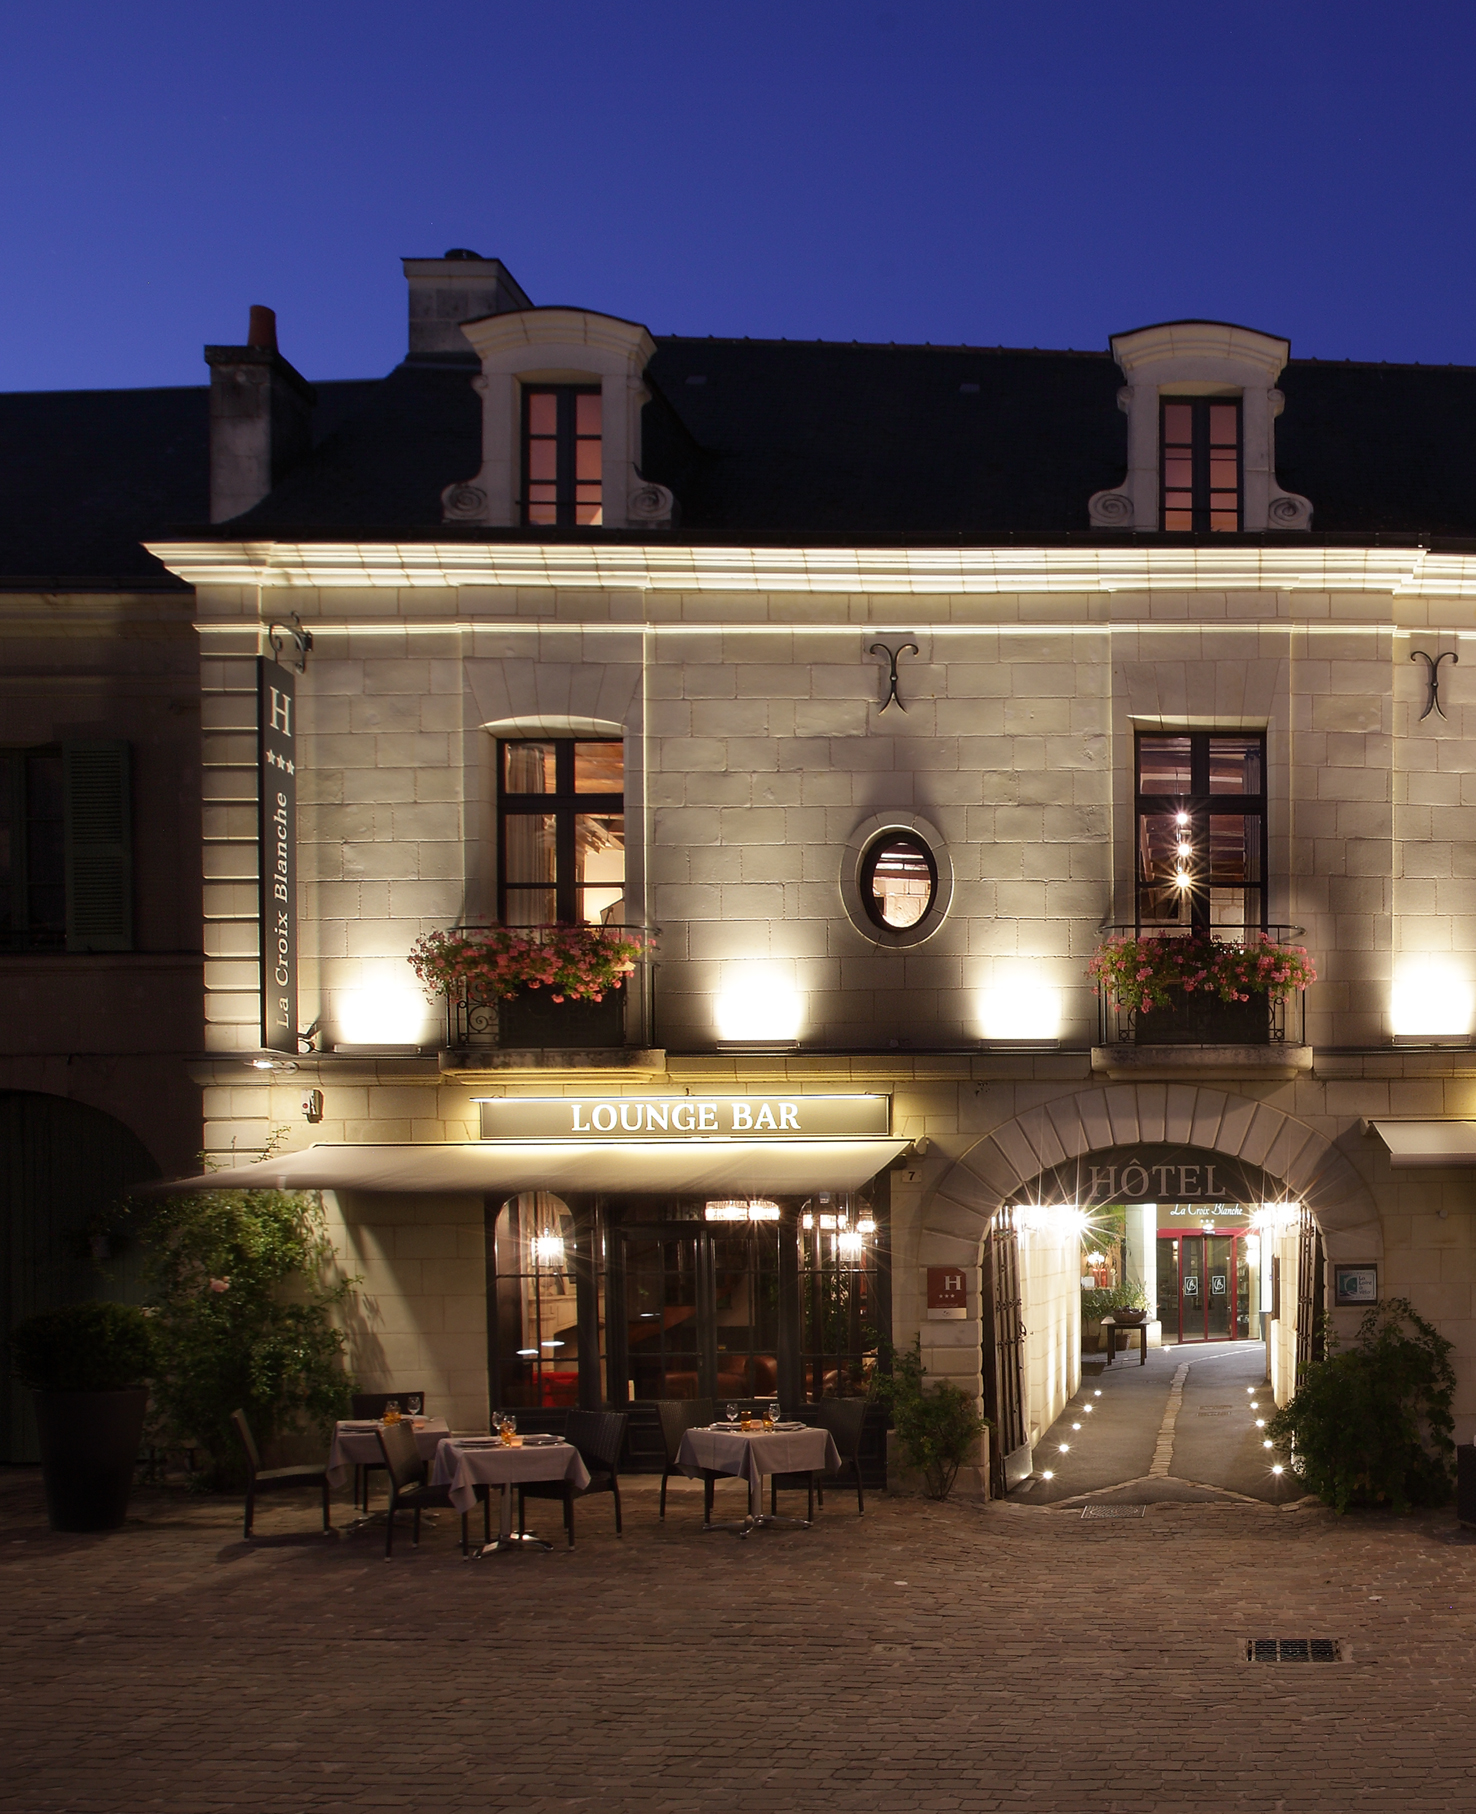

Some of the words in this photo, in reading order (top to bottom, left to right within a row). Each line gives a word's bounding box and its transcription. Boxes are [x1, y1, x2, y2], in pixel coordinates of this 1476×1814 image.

[269, 685, 292, 738] H
[274, 791, 289, 904] Blanche
[274, 911, 290, 990] Croix
[276, 997, 290, 1030] La
[571, 1102, 719, 1132] LOUNGE
[731, 1102, 802, 1131] BAR
[1088, 1158, 1226, 1197] HÔTEL
[1170, 1203, 1186, 1216] La
[1188, 1203, 1210, 1216] Croix
[1211, 1203, 1243, 1216] Blanche
[944, 1275, 962, 1291] H
